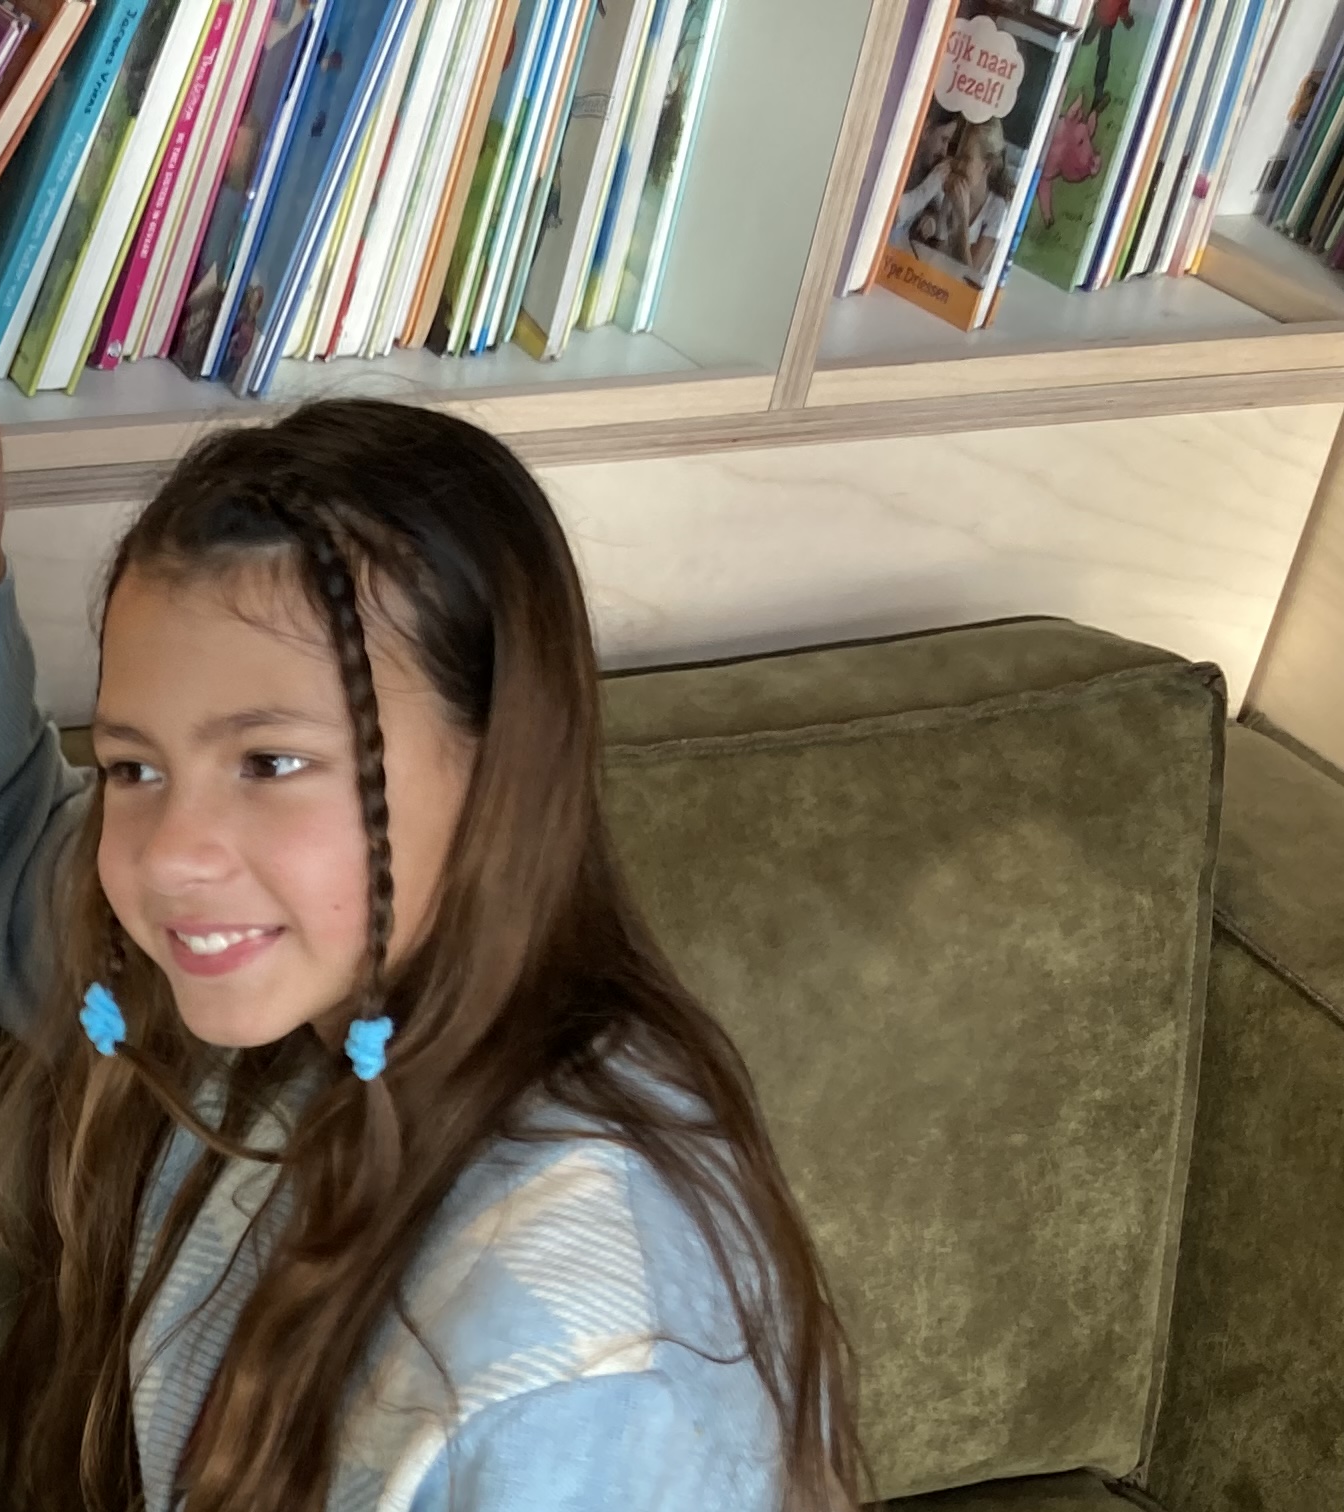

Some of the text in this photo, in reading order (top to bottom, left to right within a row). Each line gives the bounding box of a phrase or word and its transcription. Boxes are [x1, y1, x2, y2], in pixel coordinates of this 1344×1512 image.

[83, 8, 139, 116] Jacques Vriens
[976, 48, 1018, 81] naar
[946, 65, 1006, 109] jezelf!
[904, 266, 950, 305] Driessen
